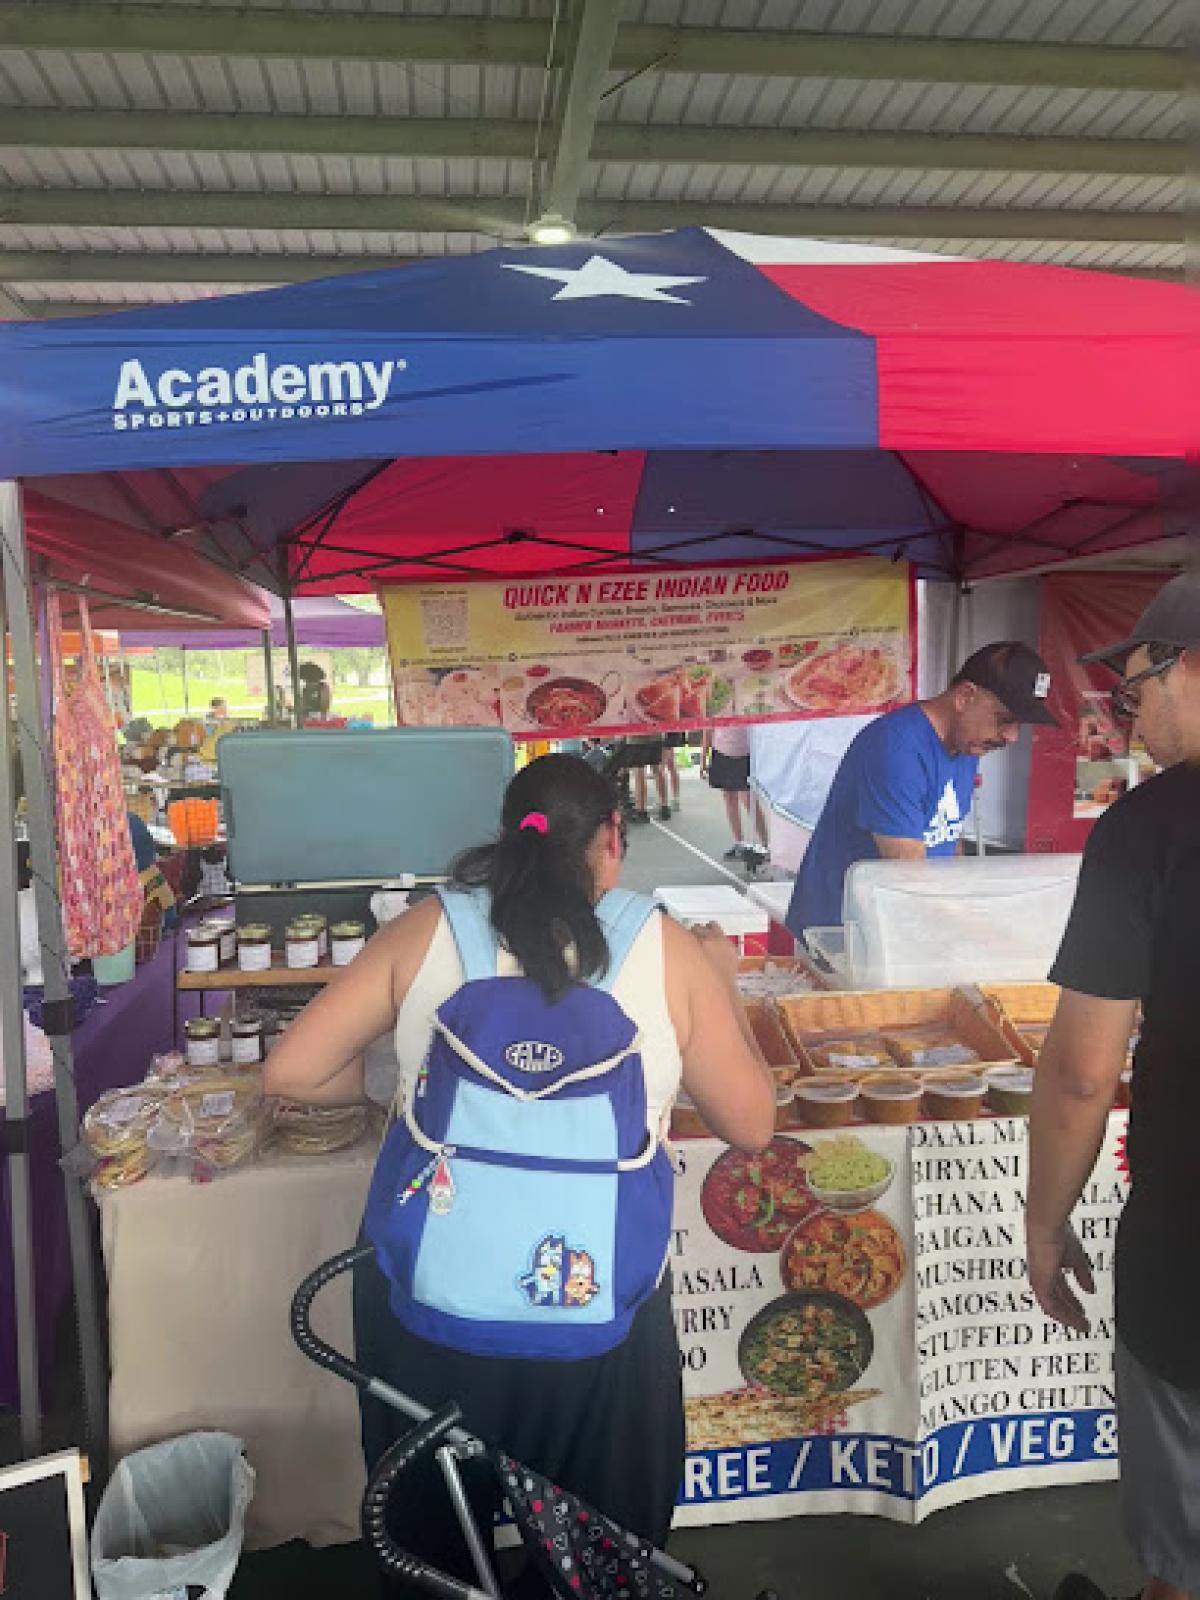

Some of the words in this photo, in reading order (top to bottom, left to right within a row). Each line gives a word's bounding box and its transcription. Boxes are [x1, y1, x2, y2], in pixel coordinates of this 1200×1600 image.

[112, 352, 394, 410] Academy
[503, 584, 569, 609] QUICK
[576, 583, 592, 603] N
[599, 581, 648, 603] EZEE
[655, 576, 728, 599] INDIAN
[732, 571, 790, 594] FOOD
[906, 1124, 987, 1148] DAAL
[914, 1155, 1021, 1186] BIRYANI
[673, 1264, 765, 1295] ASALA
[917, 1257, 1028, 1289] MUSHRO
[918, 1290, 1035, 1330] SAMOSAS
[918, 1322, 1034, 1365] STUFFED
[919, 1356, 1020, 1398] GLUTEN
[1030, 1352, 1099, 1377] FREE
[683, 1447, 772, 1498] REE
[830, 1437, 939, 1494] KETO
[990, 1416, 1075, 1464] VEG
